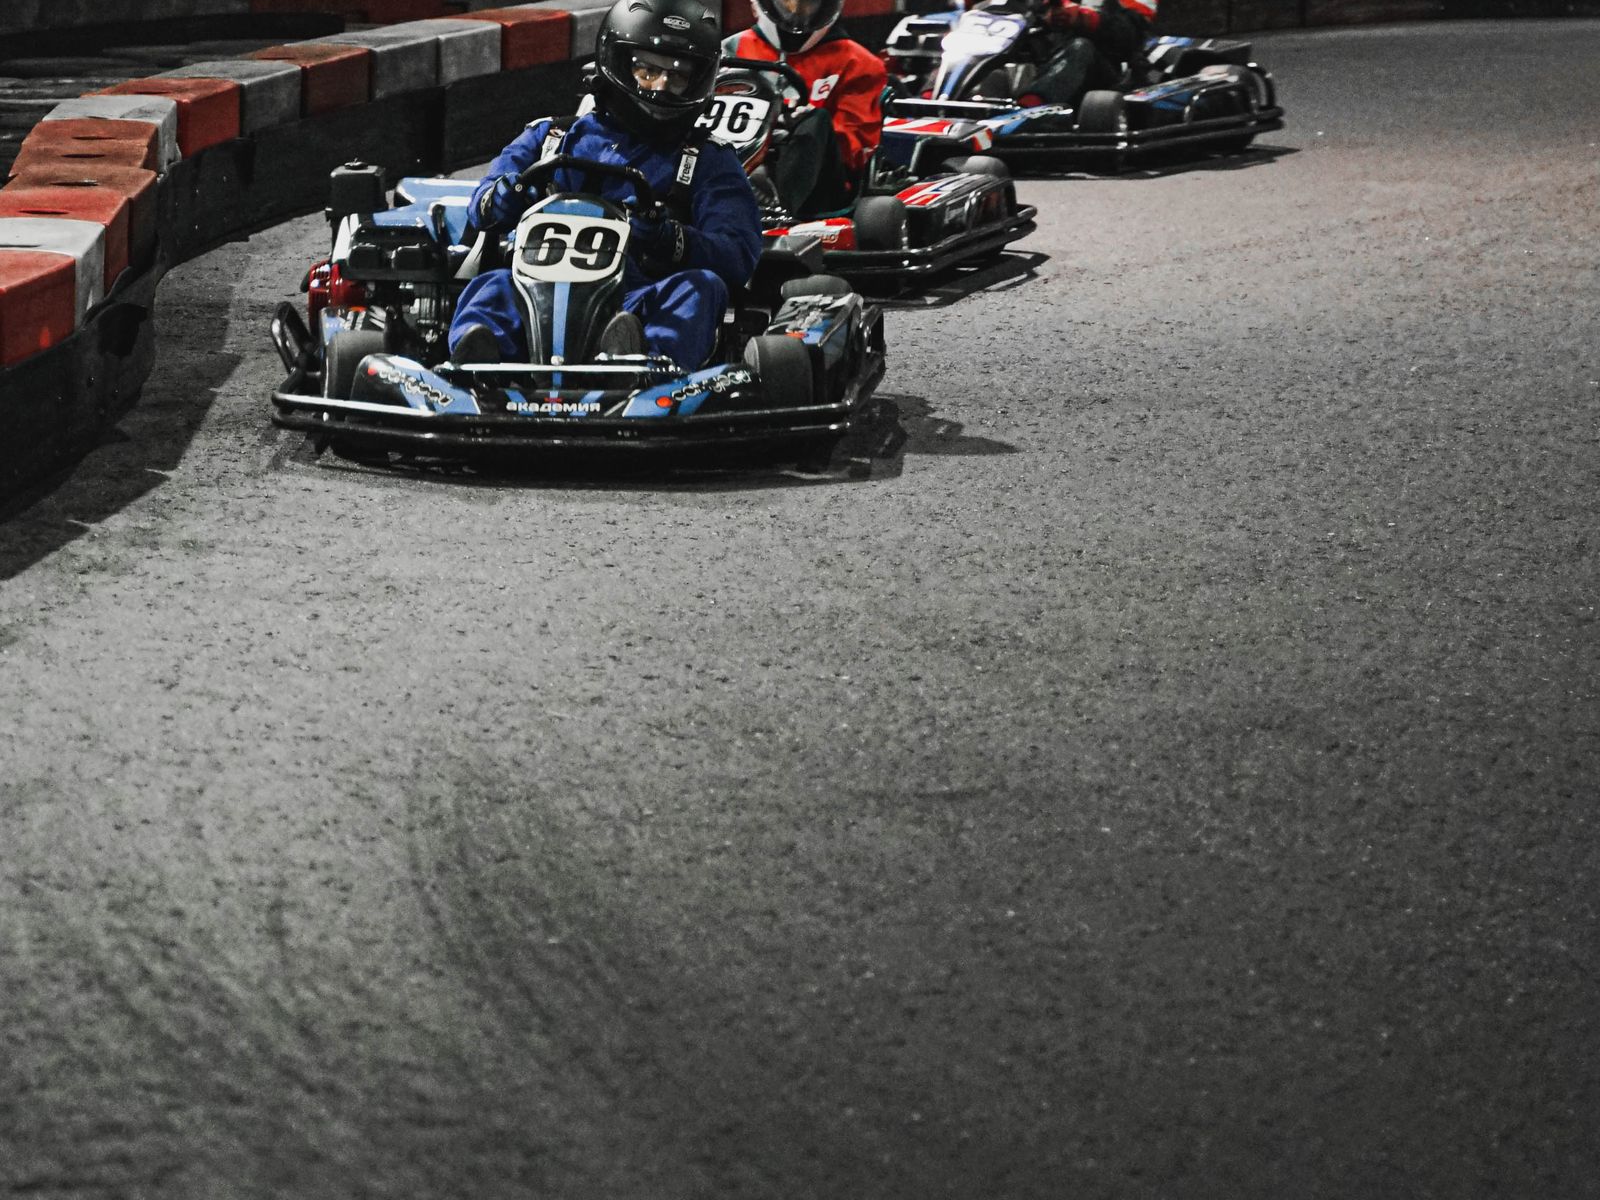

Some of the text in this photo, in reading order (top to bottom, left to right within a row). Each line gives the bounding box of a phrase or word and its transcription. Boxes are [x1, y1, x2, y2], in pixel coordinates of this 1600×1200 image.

[700, 100, 754, 133] 96
[521, 222, 621, 271] 69
[506, 401, 601, 413] академия
